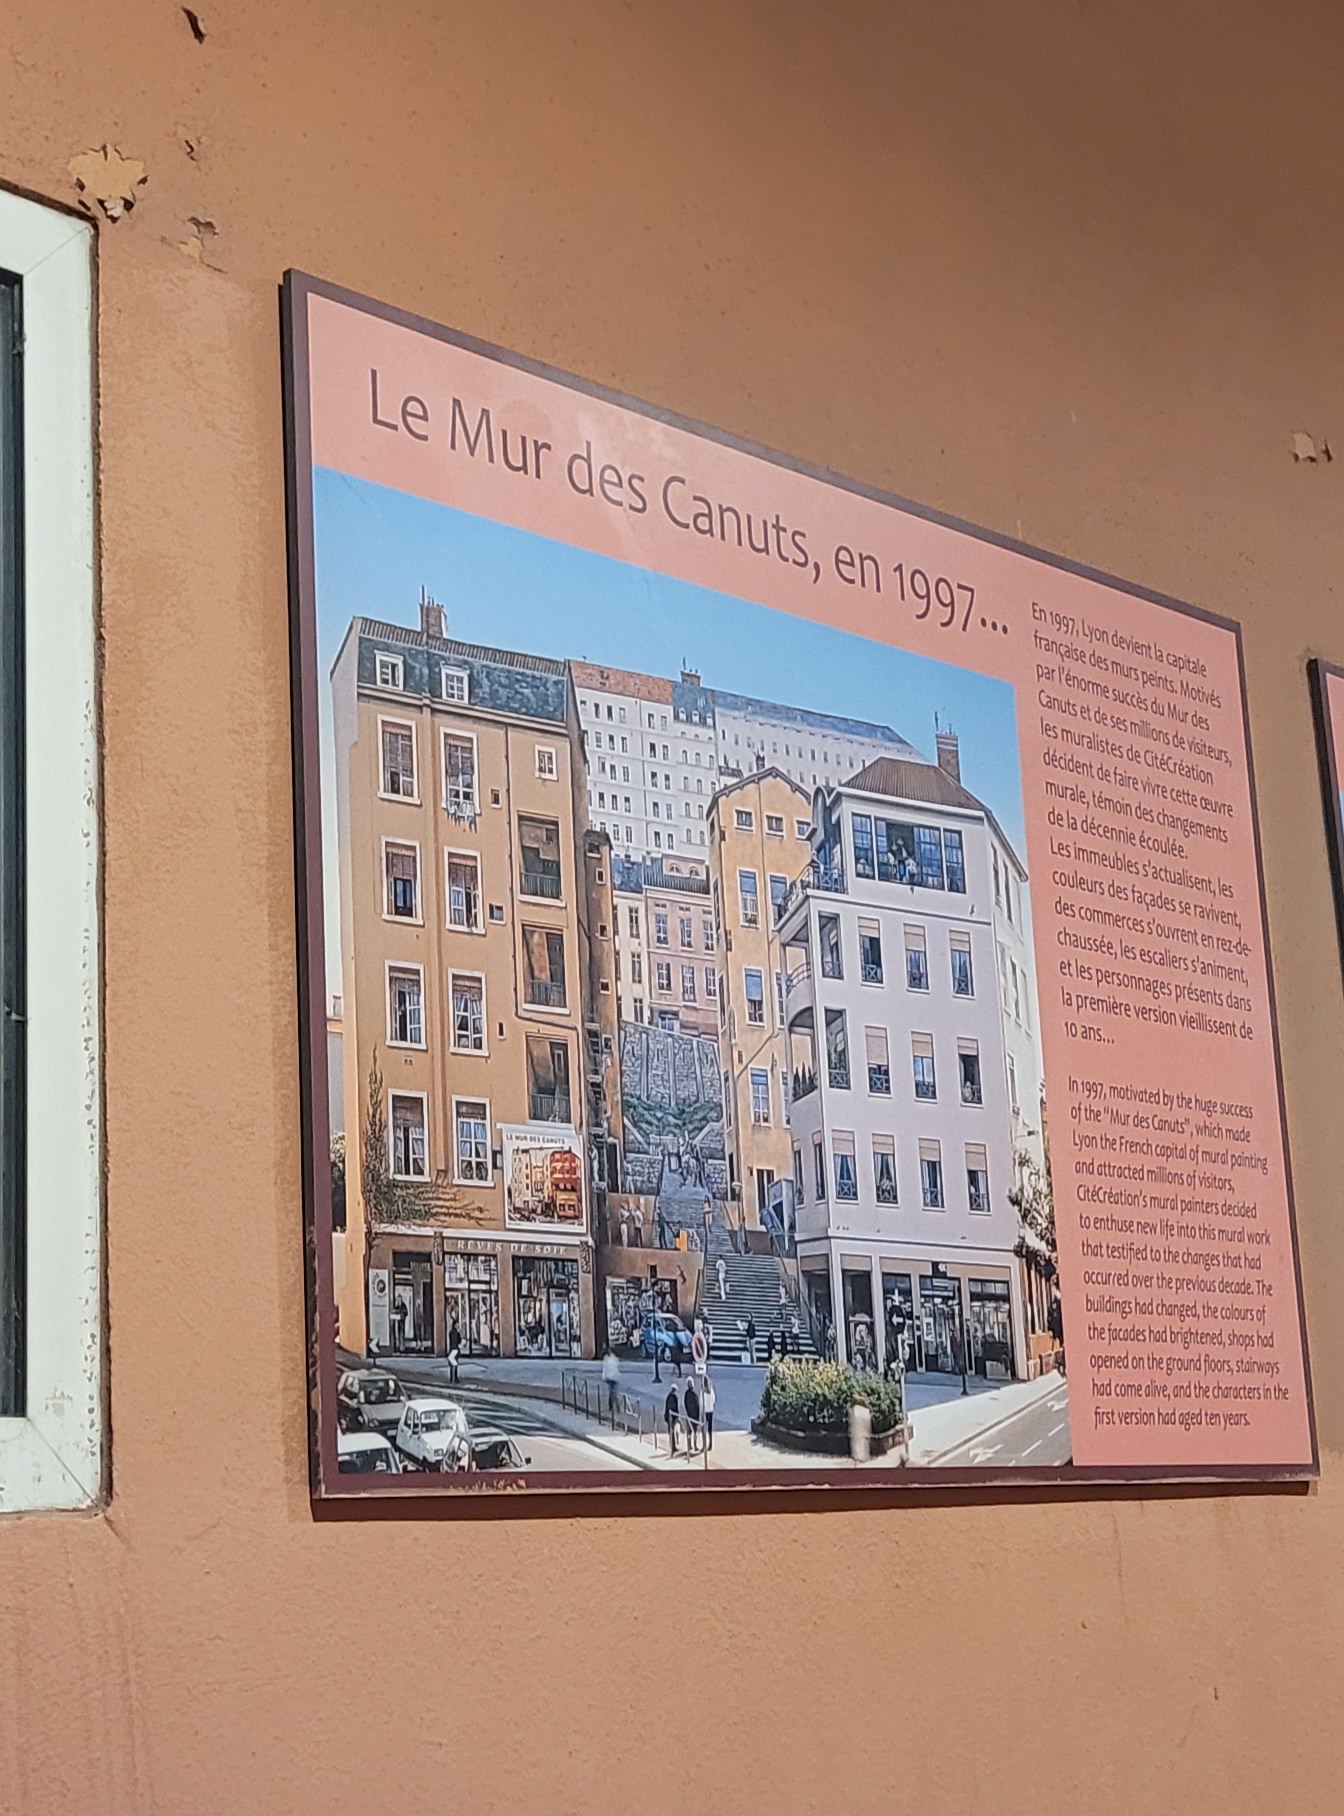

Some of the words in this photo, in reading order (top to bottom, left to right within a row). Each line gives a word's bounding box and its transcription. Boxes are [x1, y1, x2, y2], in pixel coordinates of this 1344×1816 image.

[369, 368, 429, 442] Le
[449, 396, 551, 480] Mur
[566, 440, 647, 515] des
[661, 475, 823, 585] Canuts,
[834, 544, 880, 593] en
[892, 561, 1008, 635] 1997...
[1031, 601, 1048, 624] En
[1049, 611, 1080, 639] 1997,
[1081, 618, 1110, 646] Lyon
[1110, 629, 1153, 660] devient
[1153, 642, 1165, 664] la
[1165, 652, 1208, 679] capitale
[1033, 628, 1087, 666] française
[1088, 648, 1110, 672] des
[1110, 660, 1140, 683] murs
[1140, 669, 1178, 695] peints.
[1179, 679, 1222, 709] Motivés
[1035, 663, 1057, 684] par
[1057, 664, 1111, 700] l'énorme
[1111, 687, 1149, 712] succès
[1150, 695, 1166, 718] du
[1166, 700, 1190, 725] Mur
[1190, 709, 1210, 732] des
[1037, 688, 1079, 718] Canuts
[1079, 703, 1093, 723] et
[1093, 704, 1109, 727] de
[1109, 714, 1129, 734] ses
[1129, 719, 1171, 747] millions
[1171, 729, 1187, 752] de
[1186, 735, 1233, 768] visiteurs,
[1039, 715, 1059, 740] les
[1060, 727, 1125, 760] muralistes
[1125, 742, 1142, 765] de
[1143, 749, 1214, 787] CitéCréation
[1042, 746, 1096, 780] décident
[1096, 761, 1112, 784] de
[1112, 765, 1140, 793] faire
[1140, 775, 1169, 800] vivre
[1169, 787, 1199, 809] cette
[1199, 796, 1234, 819] œuvre
[1044, 780, 1091, 813] murale,
[1091, 789, 1134, 819] témoin
[1134, 800, 1155, 824] des
[1155, 806, 1229, 844] changements
[1047, 805, 1065, 828] de
[1065, 809, 1079, 832] la
[1080, 813, 1137, 847] décennie
[1138, 828, 1189, 860] écoulée.
[1068, 1075, 1080, 1096] In
[1080, 1080, 1107, 1105] 1997,
[1108, 1083, 1161, 1106] motivated
[1161, 1088, 1175, 1113] by
[1175, 1090, 1193, 1111] the
[1193, 1093, 1219, 1119] huge
[1219, 1101, 1254, 1120] success
[1070, 1101, 1083, 1126] of
[1083, 1102, 1102, 1124] the
[1132, 1109, 1151, 1130] des
[1194, 1119, 1224, 1141] which
[1224, 1124, 1252, 1144] made
[506, 1133, 513, 1141] LE
[514, 1134, 528, 1142] MUR
[529, 1134, 541, 1143] DES
[1072, 1128, 1099, 1153] Lyon
[1099, 1131, 1118, 1153] the
[1118, 1135, 1154, 1158] French
[1151, 1137, 1188, 1164] capital
[1188, 1143, 1200, 1167] of
[1201, 1147, 1229, 1166] mural
[1230, 1150, 1269, 1176] painting
[510, 1243, 528, 1253] DE
